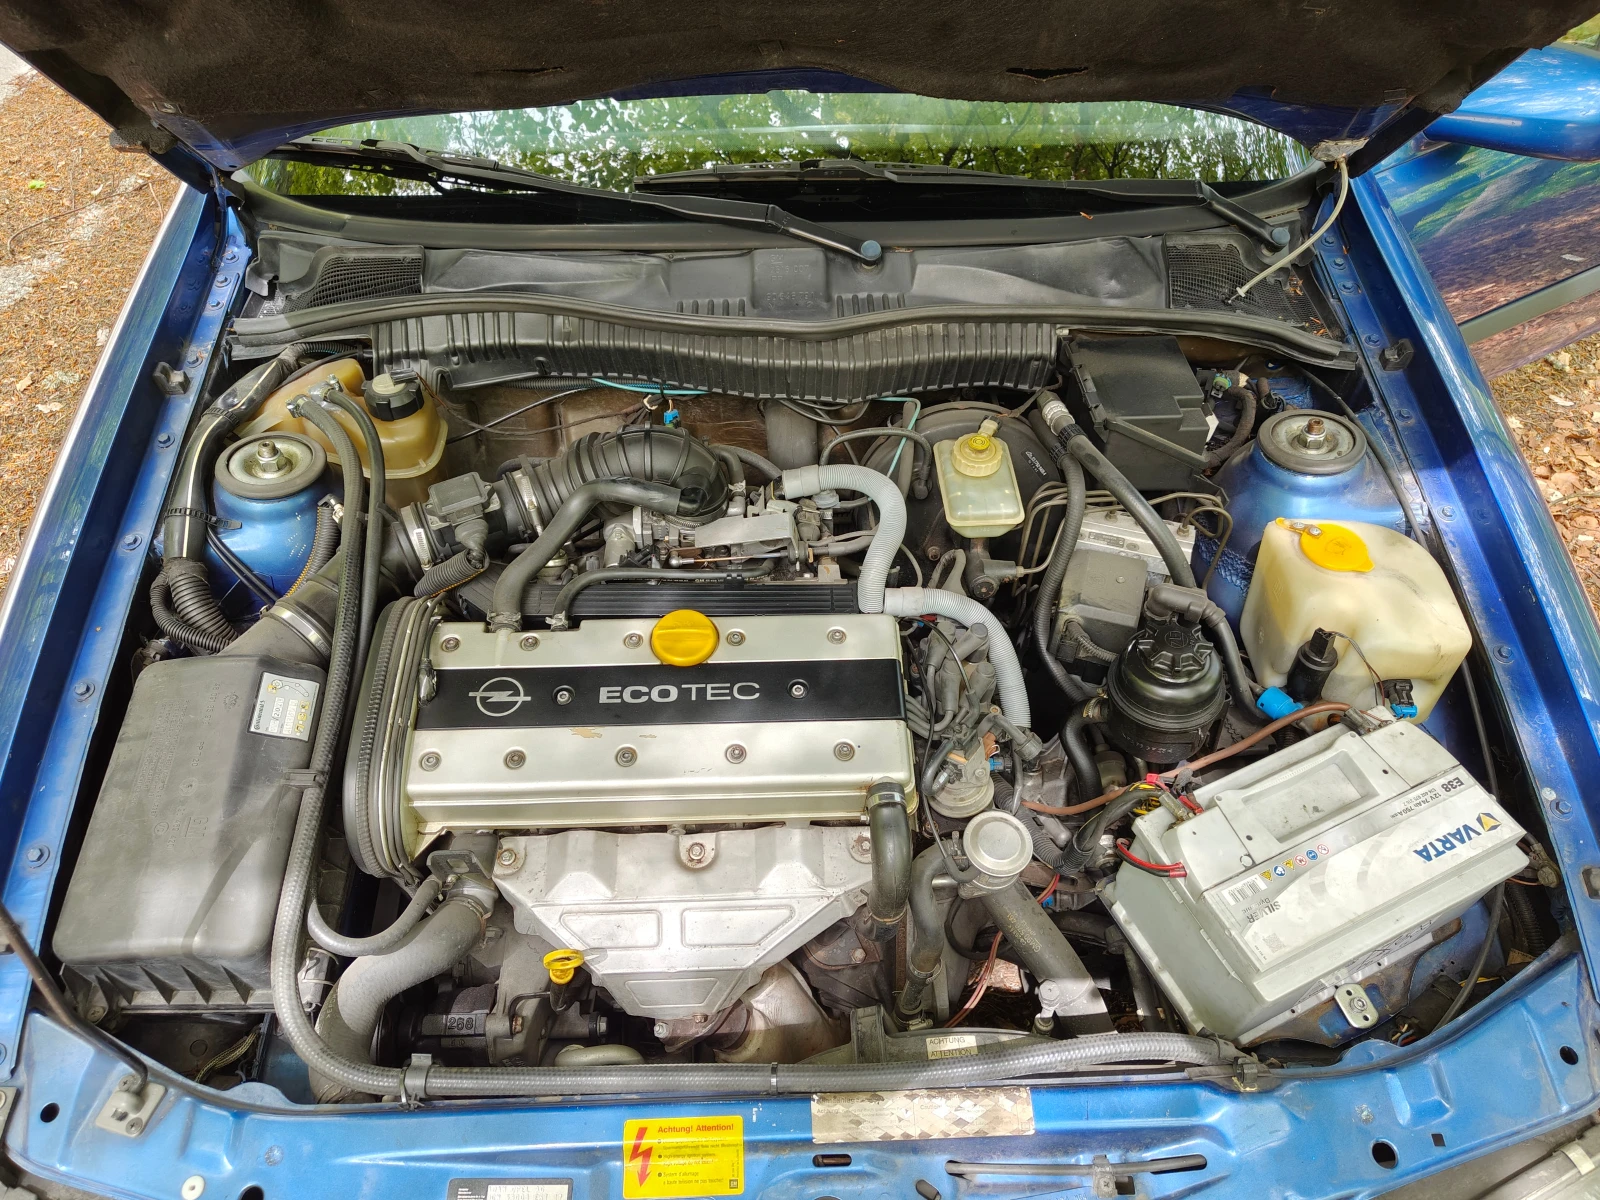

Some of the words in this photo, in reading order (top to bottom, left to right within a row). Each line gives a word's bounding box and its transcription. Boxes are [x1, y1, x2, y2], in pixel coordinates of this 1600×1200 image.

[598, 682, 760, 704] ECOTEC
[1441, 777, 1464, 793] E38
[1413, 824, 1482, 862] VARTA
[1247, 900, 1281, 924] SILVER
[931, 1049, 972, 1058] ATTENTION
[658, 1126, 693, 1134] Achtung!
